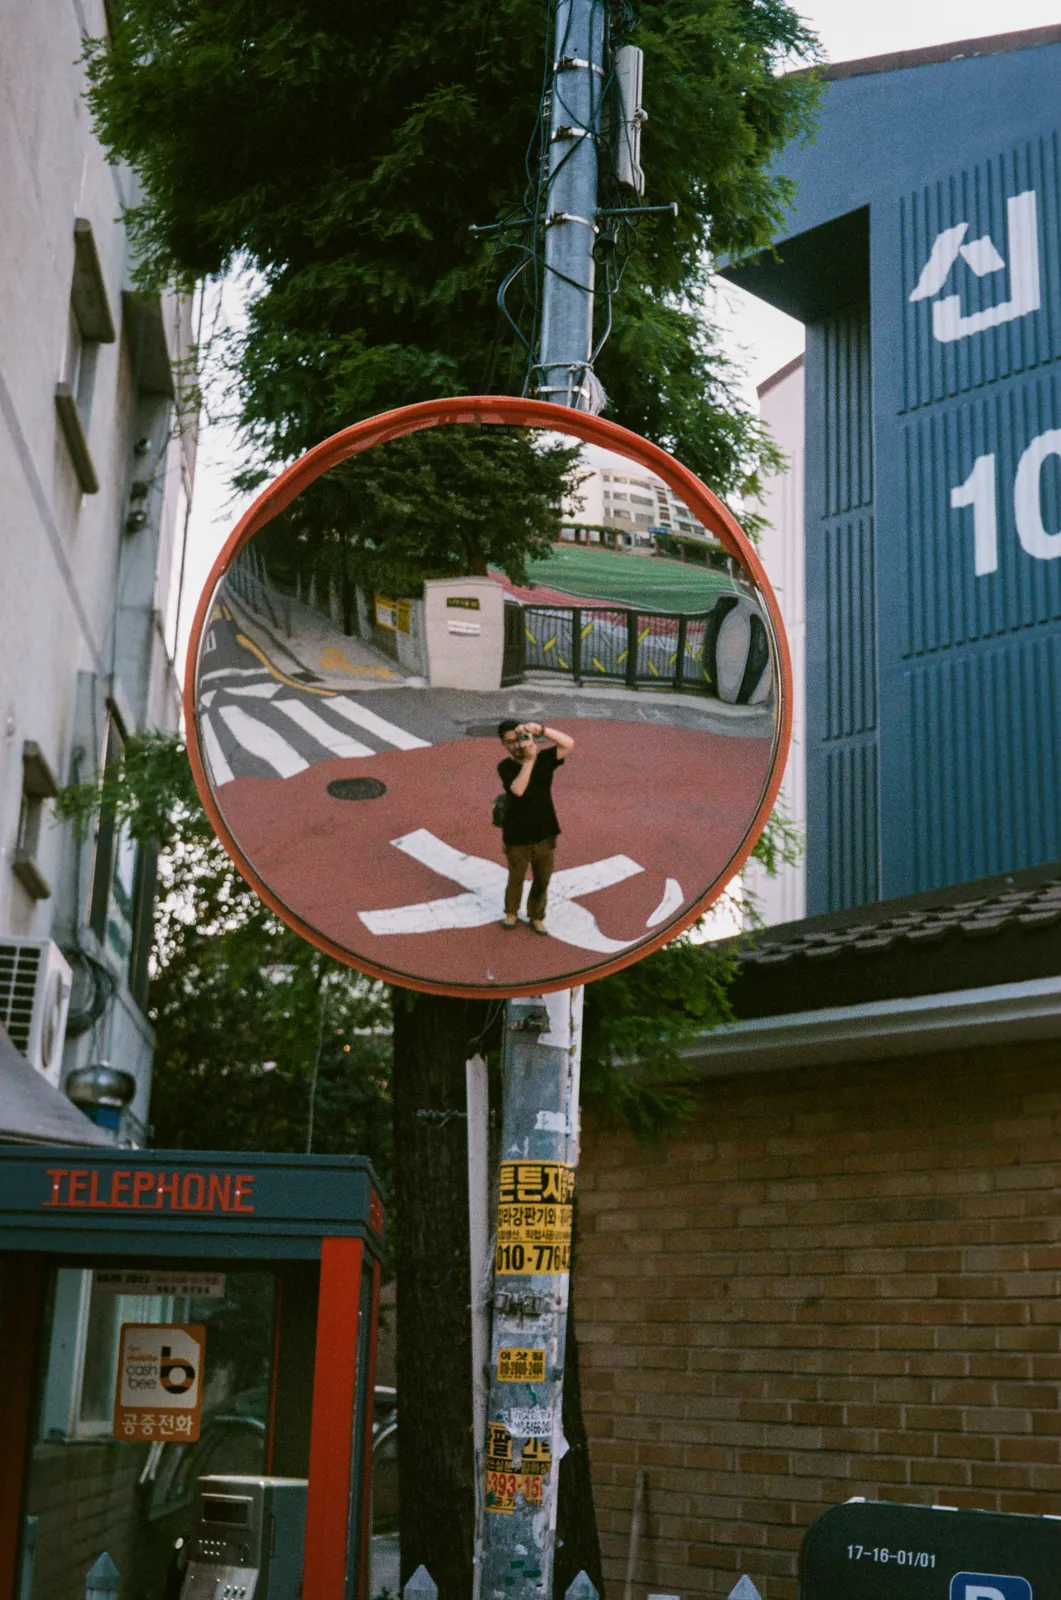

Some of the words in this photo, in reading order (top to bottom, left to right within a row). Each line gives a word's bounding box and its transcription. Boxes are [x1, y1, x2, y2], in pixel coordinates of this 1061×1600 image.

[909, 190, 1041, 343] 신
[44, 1168, 256, 1213] TELEPHONE
[126, 1364, 158, 1375] cash
[128, 1375, 157, 1389] bee
[121, 1413, 194, 1436] 공중전화
[847, 1545, 936, 1568] 17-16-01/01
